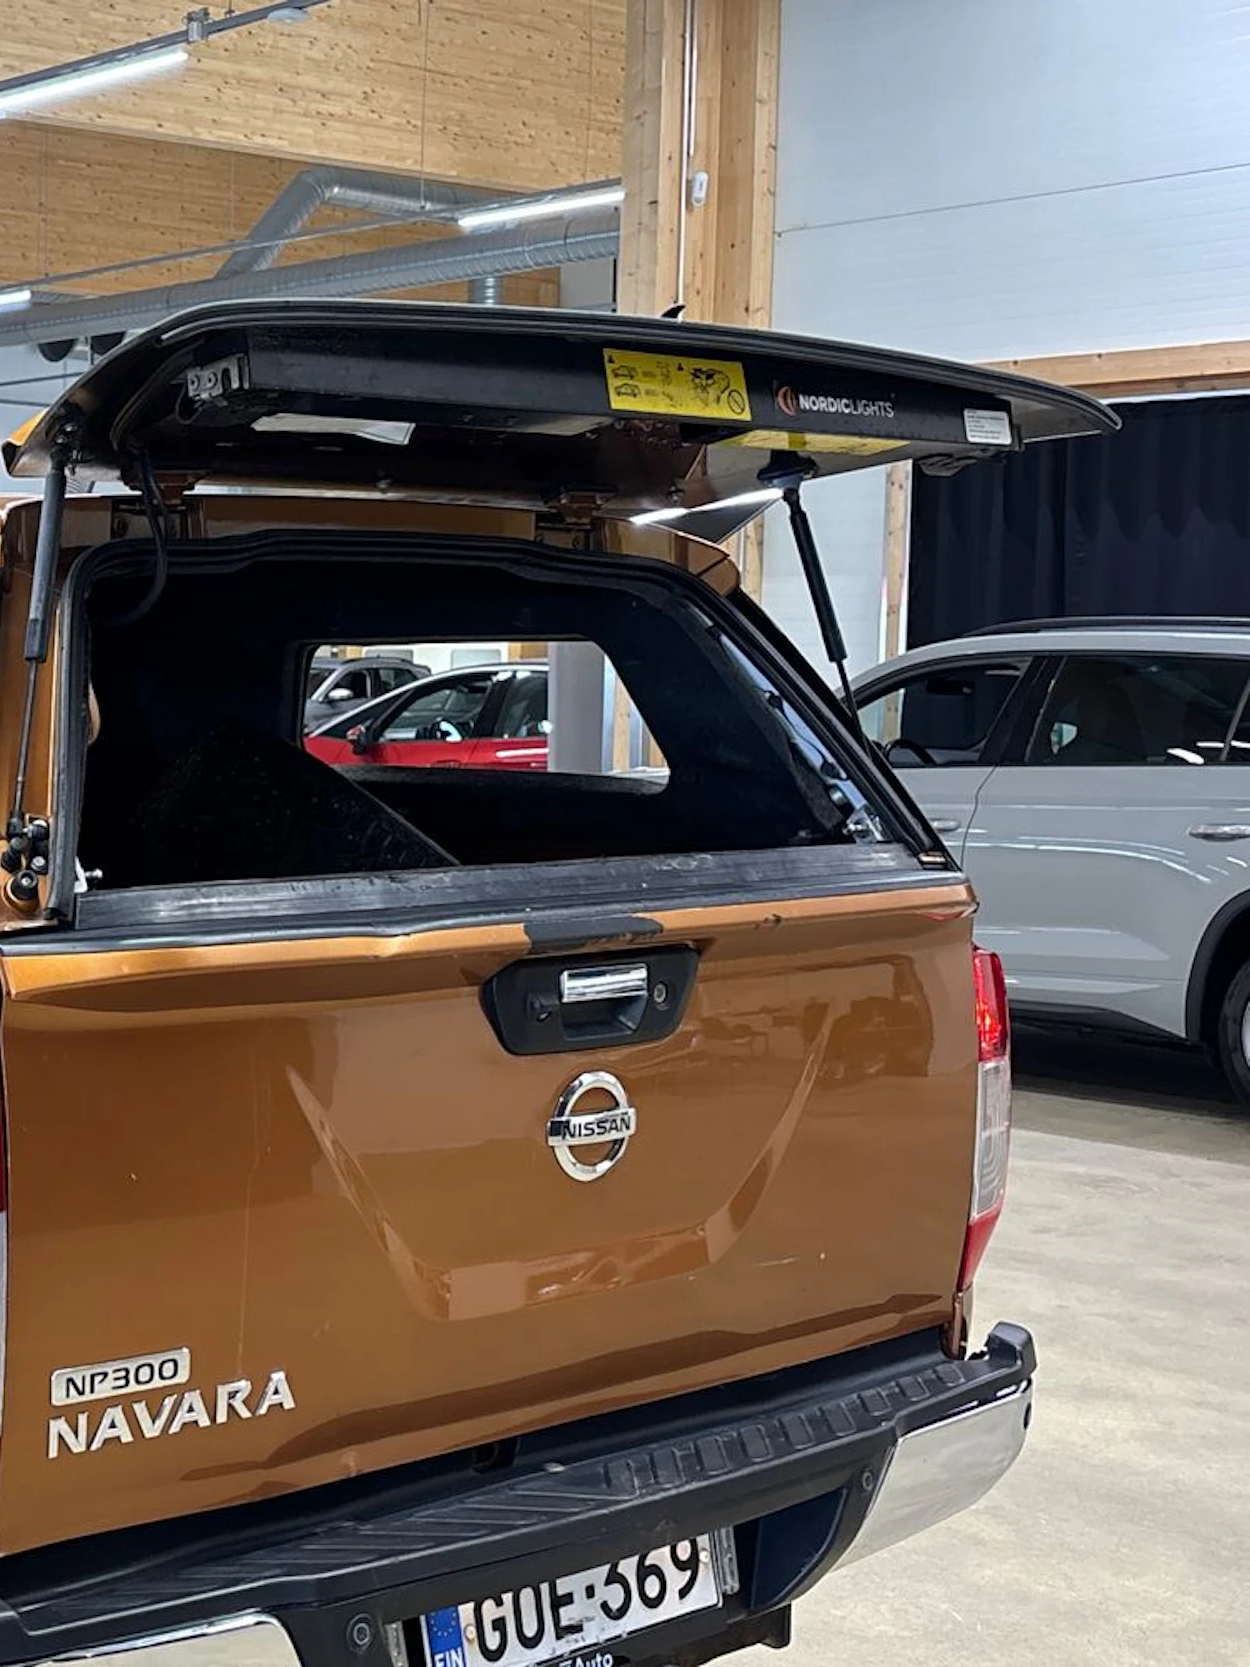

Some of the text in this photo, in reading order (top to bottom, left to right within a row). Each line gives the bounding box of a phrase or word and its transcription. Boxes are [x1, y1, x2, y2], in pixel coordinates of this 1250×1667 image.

[798, 393, 895, 418] NORDICLIGHTS
[561, 1116, 631, 1139] NISSAN
[65, 1357, 179, 1399] NP300
[48, 1371, 297, 1459] NAVARA
